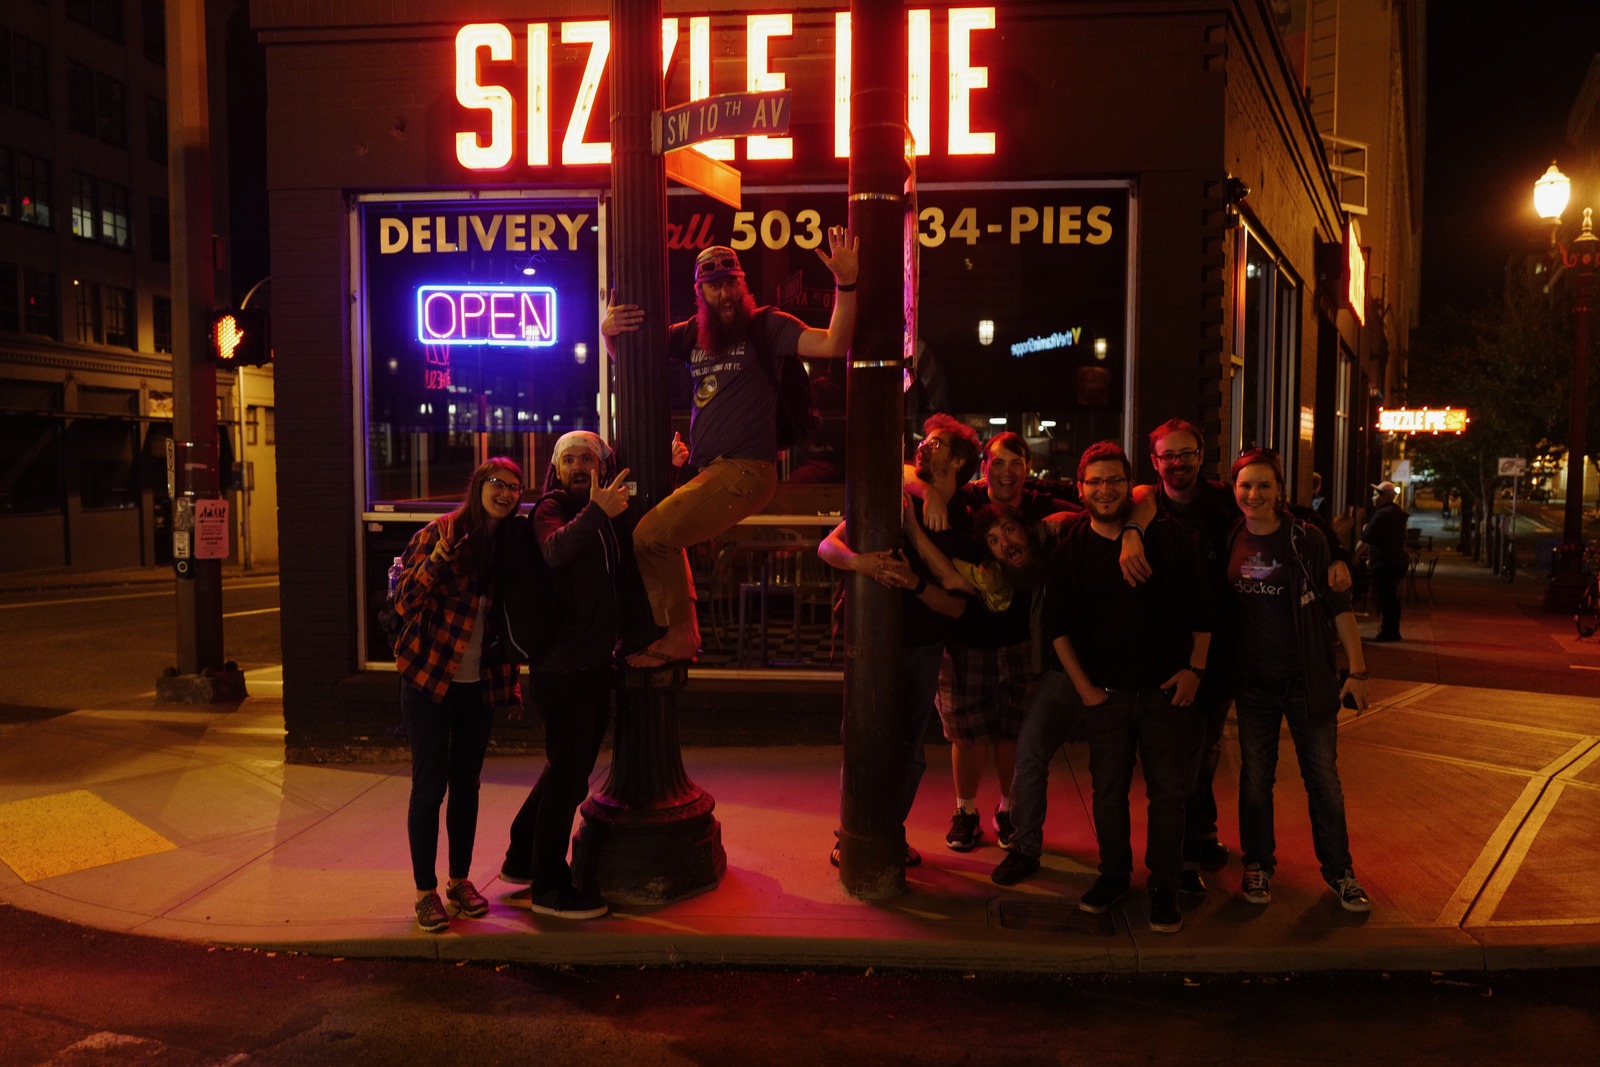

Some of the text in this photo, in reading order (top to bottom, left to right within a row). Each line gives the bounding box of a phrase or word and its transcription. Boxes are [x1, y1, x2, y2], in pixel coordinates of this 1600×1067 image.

[455, 14, 793, 170] SIZLE
[667, 110, 690, 146] SW
[752, 97, 784, 129] AV
[380, 213, 589, 254] DELIVERY
[667, 212, 715, 250] all
[424, 291, 551, 339] OPEN
[1380, 411, 1424, 430] SIZZLE
[1424, 411, 1447, 430] PIE
[1234, 580, 1285, 596] docker
